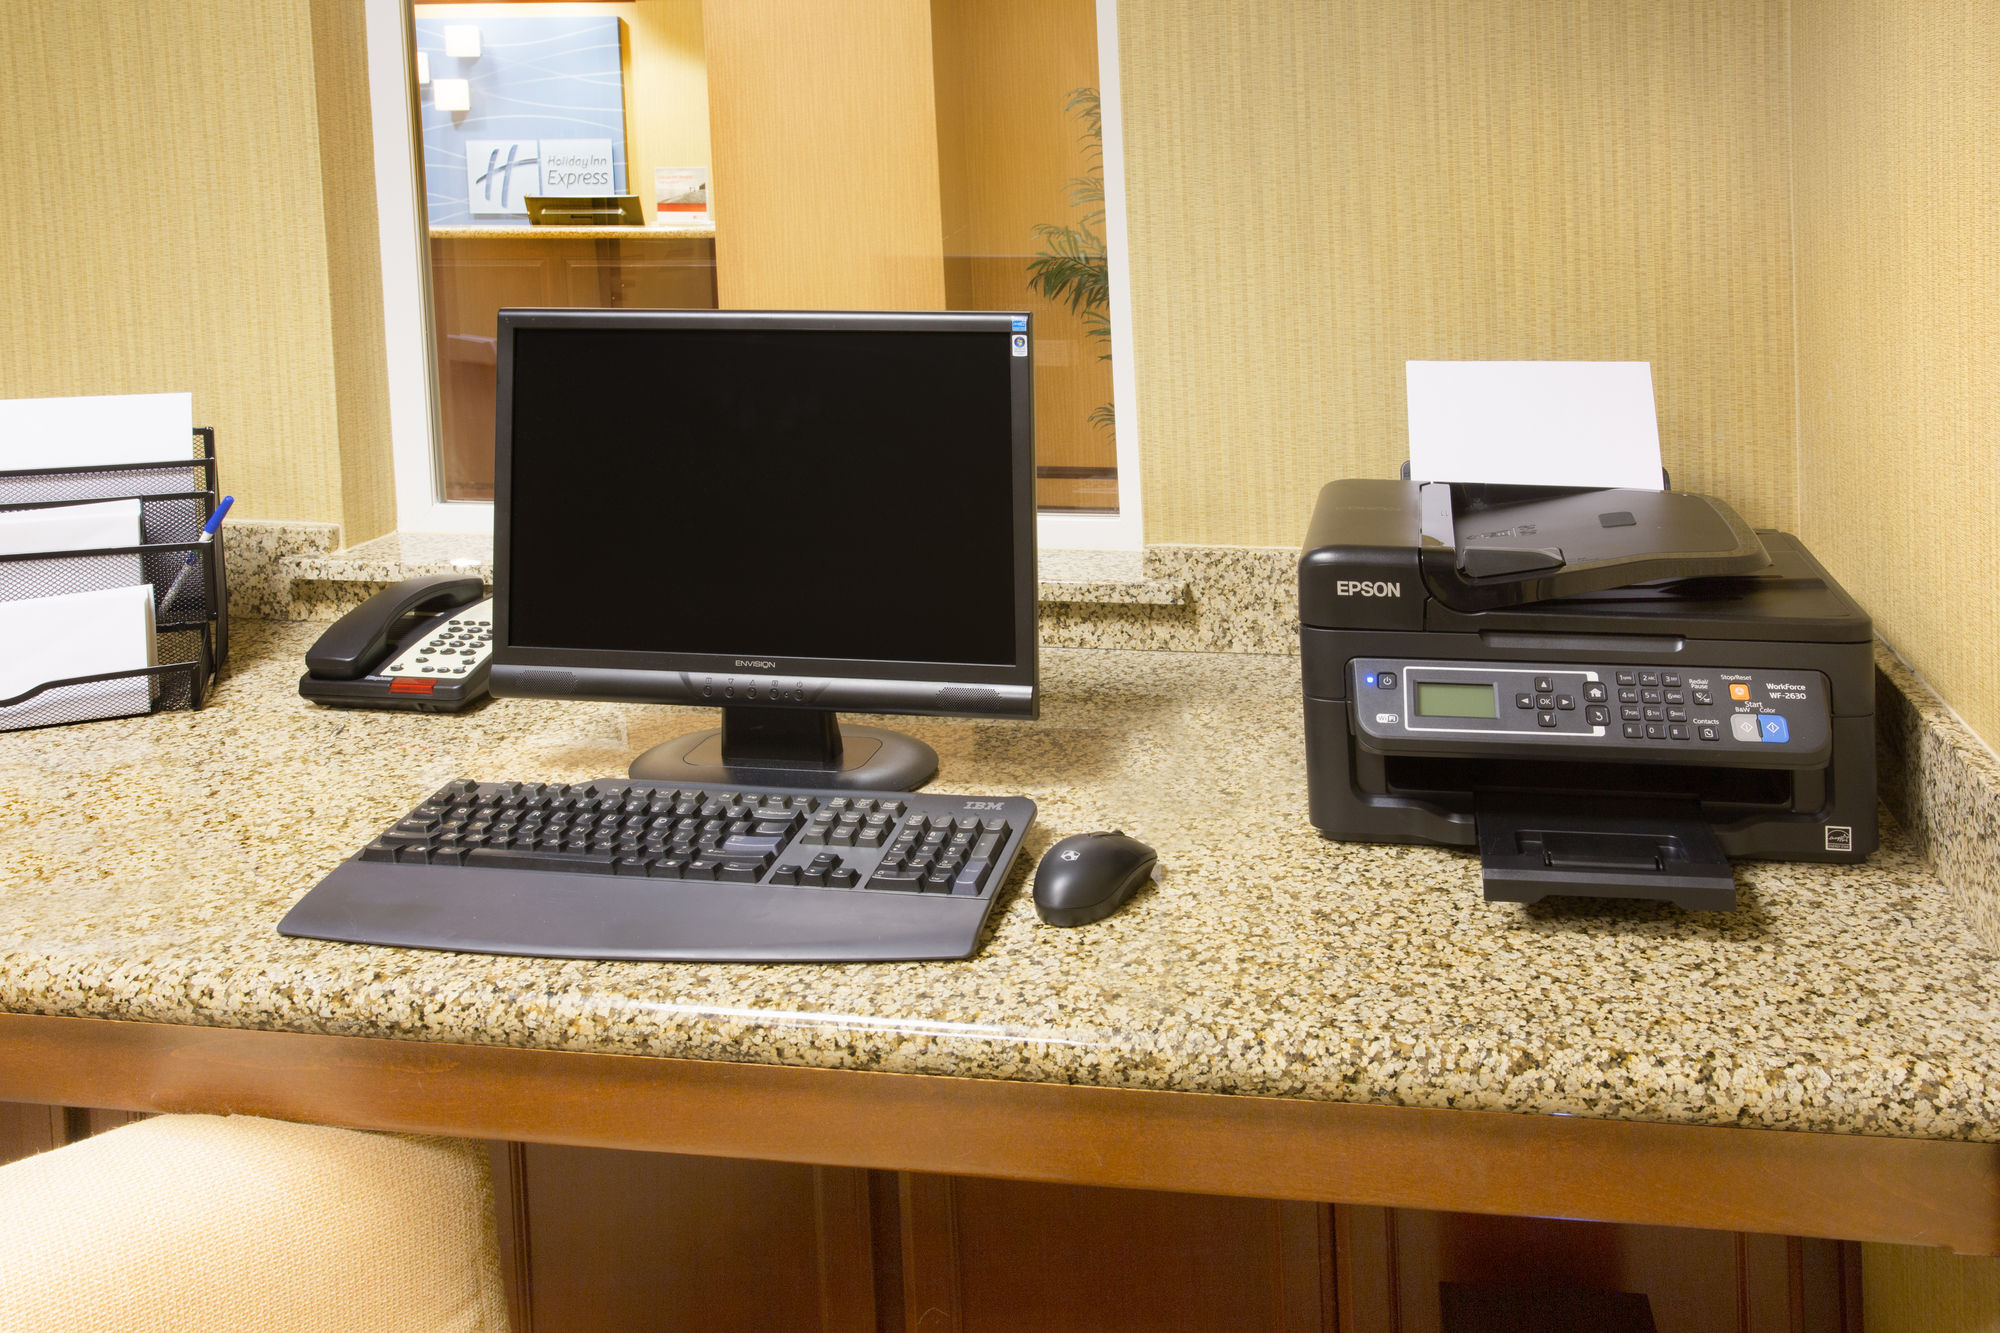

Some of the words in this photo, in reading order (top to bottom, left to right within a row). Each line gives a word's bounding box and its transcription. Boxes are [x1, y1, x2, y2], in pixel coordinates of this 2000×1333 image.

[547, 155, 588, 168] Holiday
[590, 155, 607, 166] Inn
[547, 169, 609, 188] Express
[1337, 580, 1400, 597] EPSON
[735, 660, 776, 669] ENVISION
[1766, 683, 1806, 691] WorkForce
[1769, 692, 1807, 700] WF-2630
[963, 801, 1005, 811] IBM
